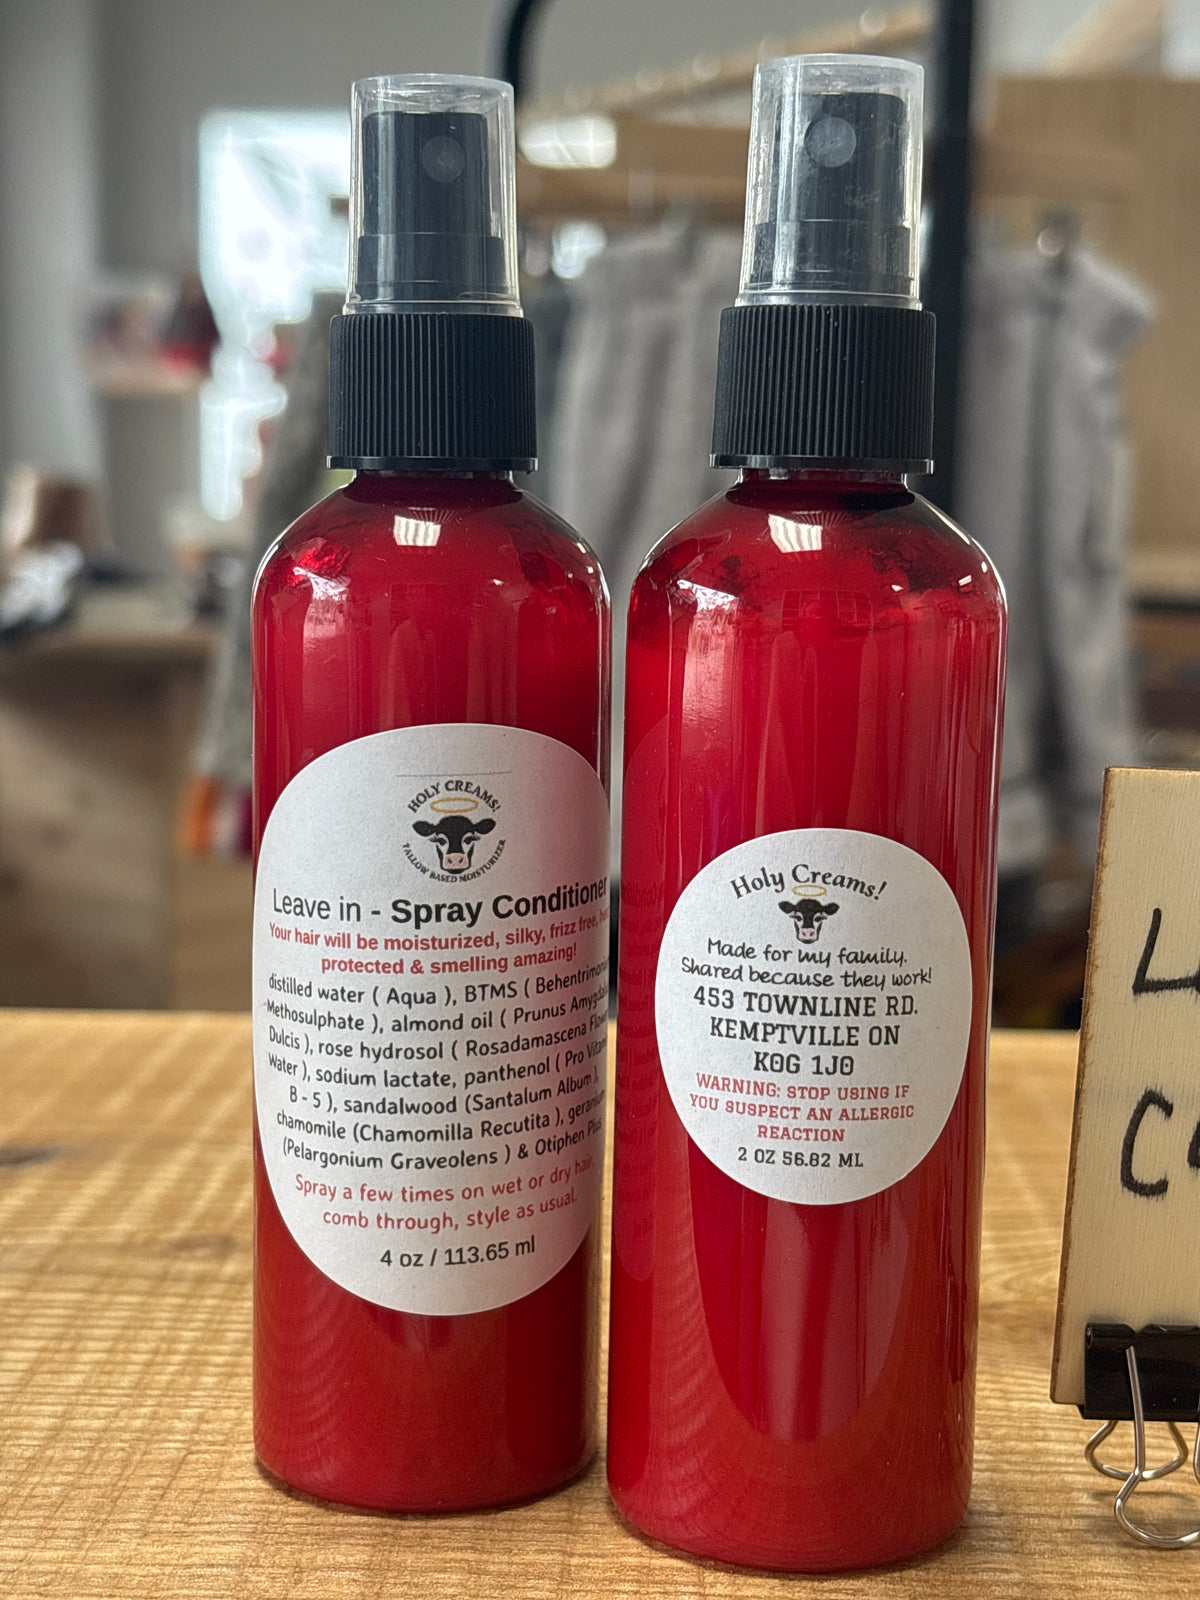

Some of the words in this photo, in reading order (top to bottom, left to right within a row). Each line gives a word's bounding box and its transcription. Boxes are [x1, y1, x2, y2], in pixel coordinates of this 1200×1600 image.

[408, 783, 440, 813] HOLY
[445, 780, 502, 813] CREAMS!
[402, 842, 430, 875] TALLOW
[429, 871, 457, 883] BASED
[459, 839, 506, 882] MOISTURIZER
[731, 866, 785, 899] Holy
[792, 864, 887, 900] Creams!
[273, 888, 330, 919] Leave
[339, 896, 361, 922] in
[391, 899, 483, 929] Spray
[493, 875, 608, 919] Conditioner
[269, 922, 291, 942] Your
[295, 929, 320, 947] hair
[324, 933, 351, 949] will
[357, 934, 378, 950] be
[384, 931, 500, 951] moisturized,
[505, 928, 546, 948] silky,
[550, 921, 577, 939] frizz
[578, 915, 599, 931] free,
[321, 957, 404, 975] protected
[410, 959, 425, 975] &
[430, 955, 508, 974] smelling
[513, 942, 577, 968] amazing!
[707, 938, 757, 959] Made
[763, 944, 792, 963] for
[798, 949, 831, 966] my
[837, 947, 908, 965] family.
[269, 973, 312, 998] distilled
[318, 986, 365, 1003] water
[386, 988, 436, 1009] Aqua
[465, 981, 517, 1002] BTMS
[681, 957, 743, 982] Shared
[749, 965, 834, 987] because
[840, 971, 886, 991] they
[891, 967, 932, 987] work!
[267, 998, 365, 1031] Methosulphate
[391, 1014, 464, 1032] almond
[472, 1010, 493, 1029] oil
[514, 1003, 566, 1024] Prunus
[693, 985, 735, 1009] 453
[743, 991, 876, 1017] TOWNLINE
[885, 995, 918, 1016] RD.
[269, 1025, 300, 1050] Dulcis
[318, 1042, 353, 1057] rose
[360, 1041, 443, 1063] hydrosol
[466, 1023, 587, 1056] Rosadamascena
[710, 1017, 859, 1046] KEMPTVILLE
[868, 1025, 900, 1046] ON
[269, 1052, 298, 1076] Water
[316, 1066, 376, 1087] sodium
[384, 1068, 457, 1089] lactate,
[464, 1056, 550, 1089] panthenol
[565, 1050, 585, 1068] Pro
[696, 1072, 781, 1098] WARNING:
[786, 1085, 831, 1100] STOP
[837, 1085, 889, 1100] USING
[895, 1085, 910, 1098] IF
[290, 1085, 298, 1102] B
[312, 1092, 321, 1109] 5
[343, 1093, 457, 1114] sandalwood
[465, 1087, 552, 1114] (Santalum
[557, 1074, 591, 1096] Album
[690, 1094, 719, 1110] YOU
[725, 1100, 801, 1120] SUSPECT
[806, 1107, 833, 1121] AN
[838, 1104, 914, 1121] ALLERGIC
[277, 1109, 346, 1139] chamomile
[353, 1119, 473, 1144] (Chamomilla
[481, 1115, 550, 1138] Recutita
[757, 1124, 845, 1142] REACTION
[283, 1136, 383, 1169] (Pelargonium
[391, 1150, 498, 1170] Graveolens
[518, 1143, 529, 1160] &
[535, 1130, 585, 1156] Otiphen
[737, 1147, 748, 1161] 2
[754, 1148, 776, 1164] OZ
[782, 1151, 831, 1168] 56.82
[838, 1152, 864, 1167] ML
[296, 1173, 337, 1200] Spray
[343, 1186, 353, 1199] a
[360, 1183, 393, 1202] few
[401, 1185, 454, 1202] times
[462, 1185, 484, 1199] on
[492, 1177, 523, 1196] wet
[529, 1174, 545, 1190] or
[550, 1166, 571, 1185] dry
[323, 1210, 368, 1228] comb
[376, 1212, 459, 1234] through,
[466, 1206, 510, 1228] style
[516, 1204, 534, 1218] as
[540, 1186, 577, 1213] usual.
[380, 1249, 392, 1267] 4
[399, 1254, 424, 1267] oz
[444, 1241, 509, 1265] 113.65
[515, 1236, 536, 1257] ml
